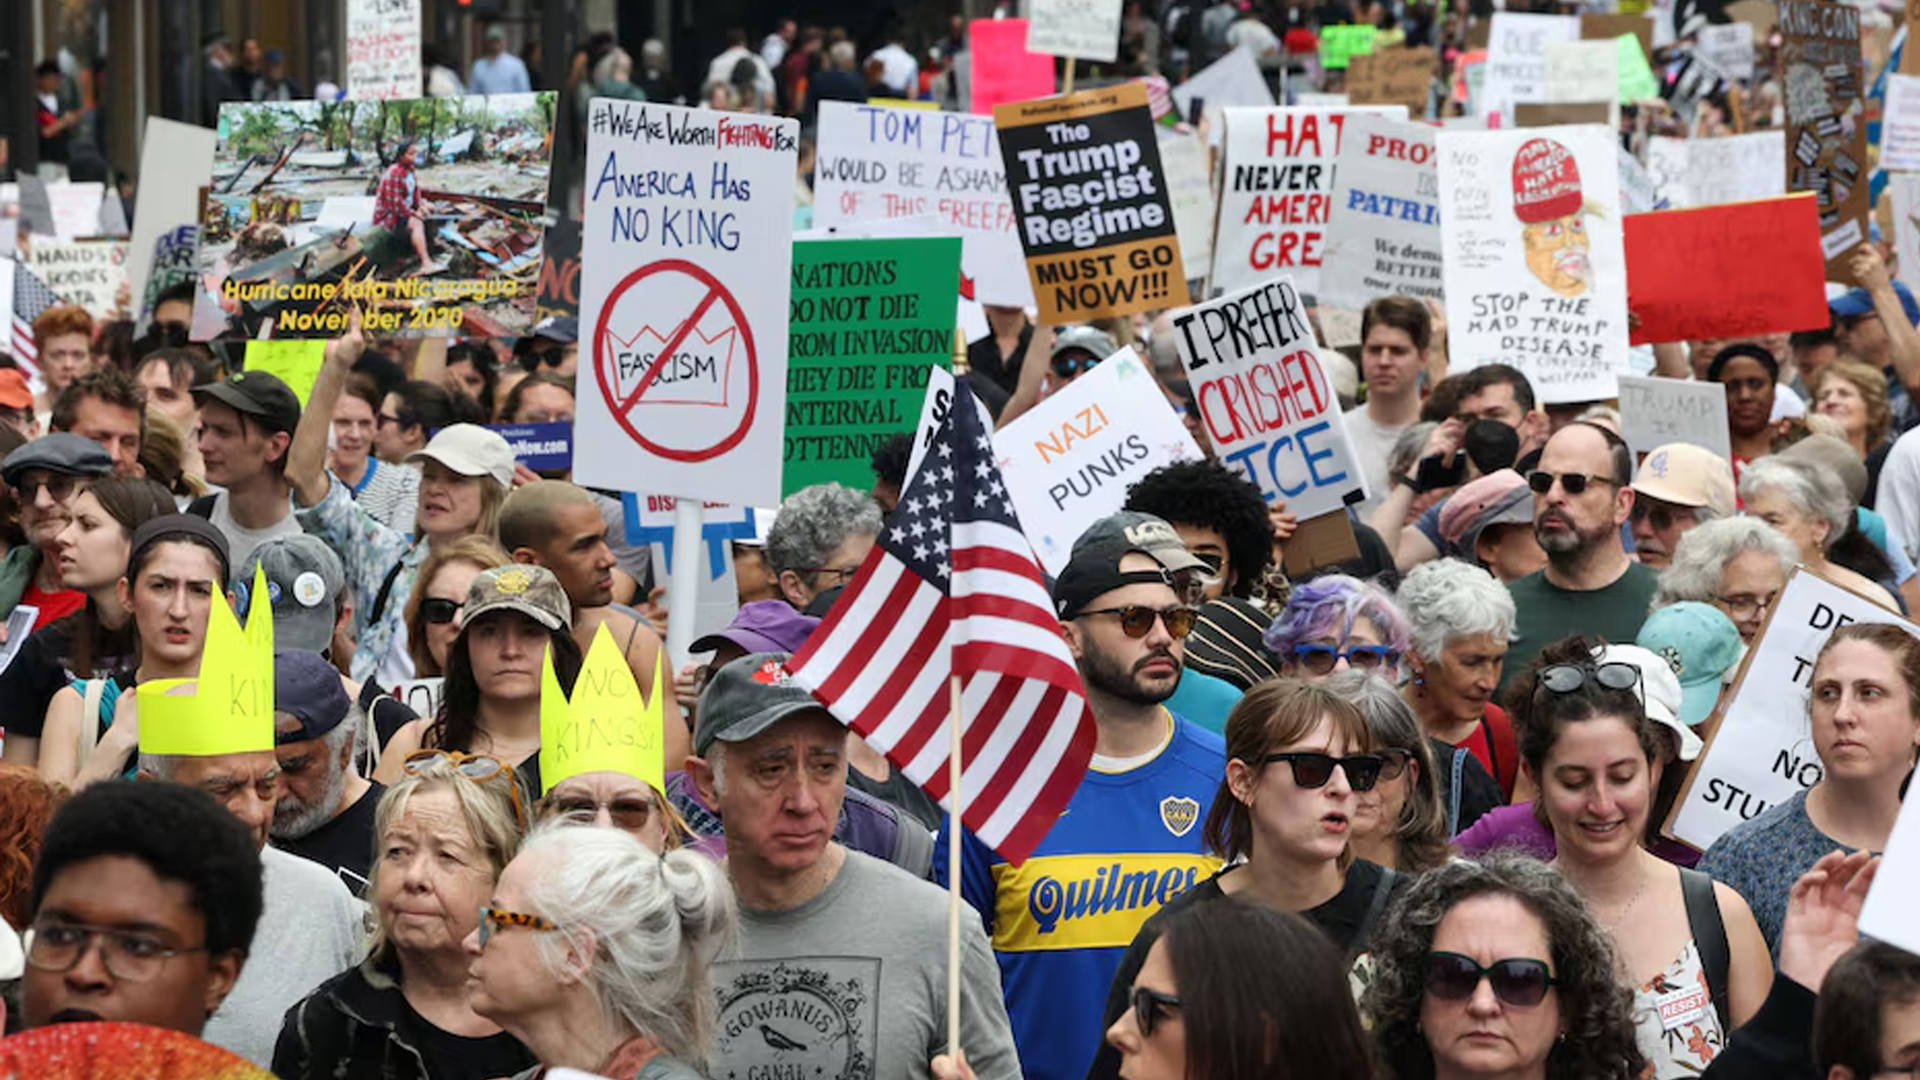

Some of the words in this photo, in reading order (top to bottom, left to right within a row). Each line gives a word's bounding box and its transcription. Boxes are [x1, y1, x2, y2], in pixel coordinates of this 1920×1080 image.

[1822, 8, 1858, 39] CON
[857, 107, 922, 150] TOM
[941, 114, 994, 158] PET
[1046, 122, 1090, 145] The
[1266, 113, 1345, 157] HAT
[592, 151, 697, 201] AMERICA
[711, 162, 751, 201] HAS
[819, 156, 887, 184] WOULD
[899, 161, 925, 189] BE
[936, 166, 1009, 194] ASHAM
[1017, 139, 1141, 180] Trump
[1019, 165, 1156, 214] Fascist
[1234, 164, 1323, 192] NEVER
[840, 190, 863, 216] OF
[938, 198, 1016, 232] FREEFA
[1024, 202, 1165, 248] Regime
[1244, 194, 1331, 224] AMERI
[611, 206, 650, 244] NO
[662, 206, 740, 251] KING
[1035, 254, 1115, 285] MUST
[1129, 245, 1173, 270] GO
[1250, 232, 1323, 271] GRE
[1374, 238, 1397, 257] We
[224, 279, 335, 301] Hurricane
[395, 277, 517, 303] Nicaragua
[791, 260, 897, 288] NATIONS
[1055, 271, 1168, 313] NOW!!!
[1363, 276, 1391, 291] our
[1394, 282, 1446, 300] count
[409, 307, 463, 329] 2020
[820, 295, 871, 322] NOT
[879, 294, 920, 320] DIE
[1472, 292, 1530, 317] STOP
[1541, 299, 1589, 316] THE
[1173, 312, 1208, 371] I
[1200, 282, 1310, 364] PREFER
[1467, 315, 1518, 333] MAD
[1530, 317, 1608, 336] TRUMP
[789, 331, 837, 358] ROM
[1501, 335, 1603, 360] DISEASE
[618, 352, 717, 387] FASCISM
[786, 366, 832, 393] HEY
[837, 365, 877, 391] DIE
[885, 363, 947, 390] FRO
[787, 398, 903, 426] NTERNAL
[1198, 349, 1330, 445] CRUSHED
[1621, 383, 1714, 417] TRUMP
[783, 432, 890, 462] OTTENN
[1034, 402, 1110, 465] NAZI
[1047, 434, 1149, 512] PUNKS
[1225, 420, 1348, 503] ICE
[230, 673, 272, 718] KIN
[582, 668, 632, 698] NO
[1772, 749, 1824, 789] NO
[1702, 777, 1775, 821] STU
[1027, 863, 1198, 935] Quilmes
[725, 998, 834, 1038] GOWANUS
[1662, 995, 1703, 1019] RESIST
[748, 1063, 806, 1080] CANAL
